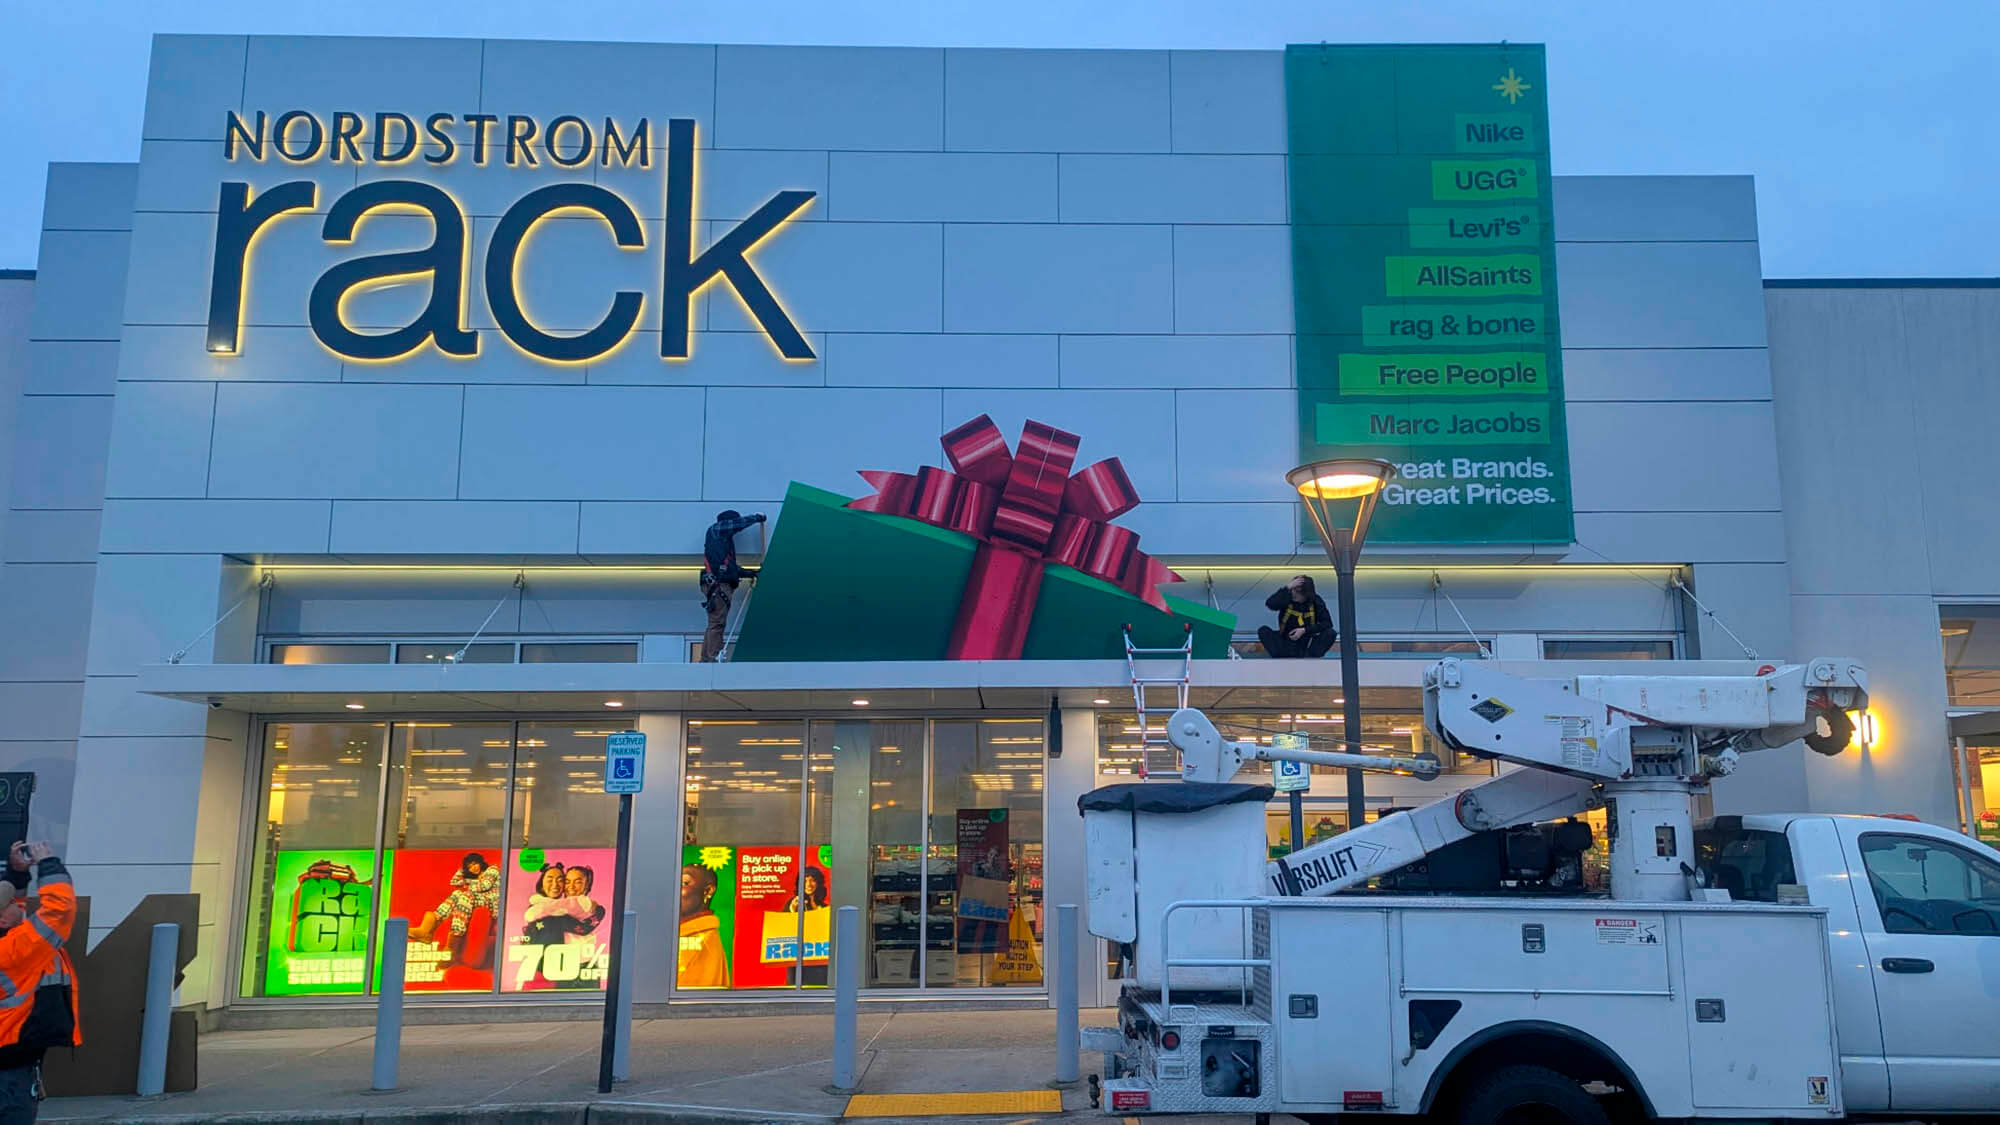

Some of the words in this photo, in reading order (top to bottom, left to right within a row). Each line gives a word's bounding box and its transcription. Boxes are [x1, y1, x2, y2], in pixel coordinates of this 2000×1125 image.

[222, 109, 655, 169] NORDSTROM
[1465, 122, 1525, 143] Nike
[206, 117, 819, 362] rack
[1416, 264, 1532, 287] AllSaints
[1389, 317, 1433, 340] rag
[1440, 314, 1459, 336] &
[1467, 314, 1536, 336] bone
[1378, 364, 1440, 385] Free
[1446, 362, 1537, 388] People
[1369, 414, 1440, 435] Marc
[1446, 411, 1542, 434] Jacobs
[1452, 456, 1554, 479] Brands.
[1382, 483, 1460, 505] Great
[1466, 483, 1556, 505] Prices.
[611, 747, 641, 756] PARKING
[742, 854, 761, 865] Buy
[751, 864, 772, 874] pick
[773, 865, 787, 874] up
[741, 874, 751, 882] in
[752, 874, 780, 882] store.
[1271, 846, 1358, 897] VRSALIFT
